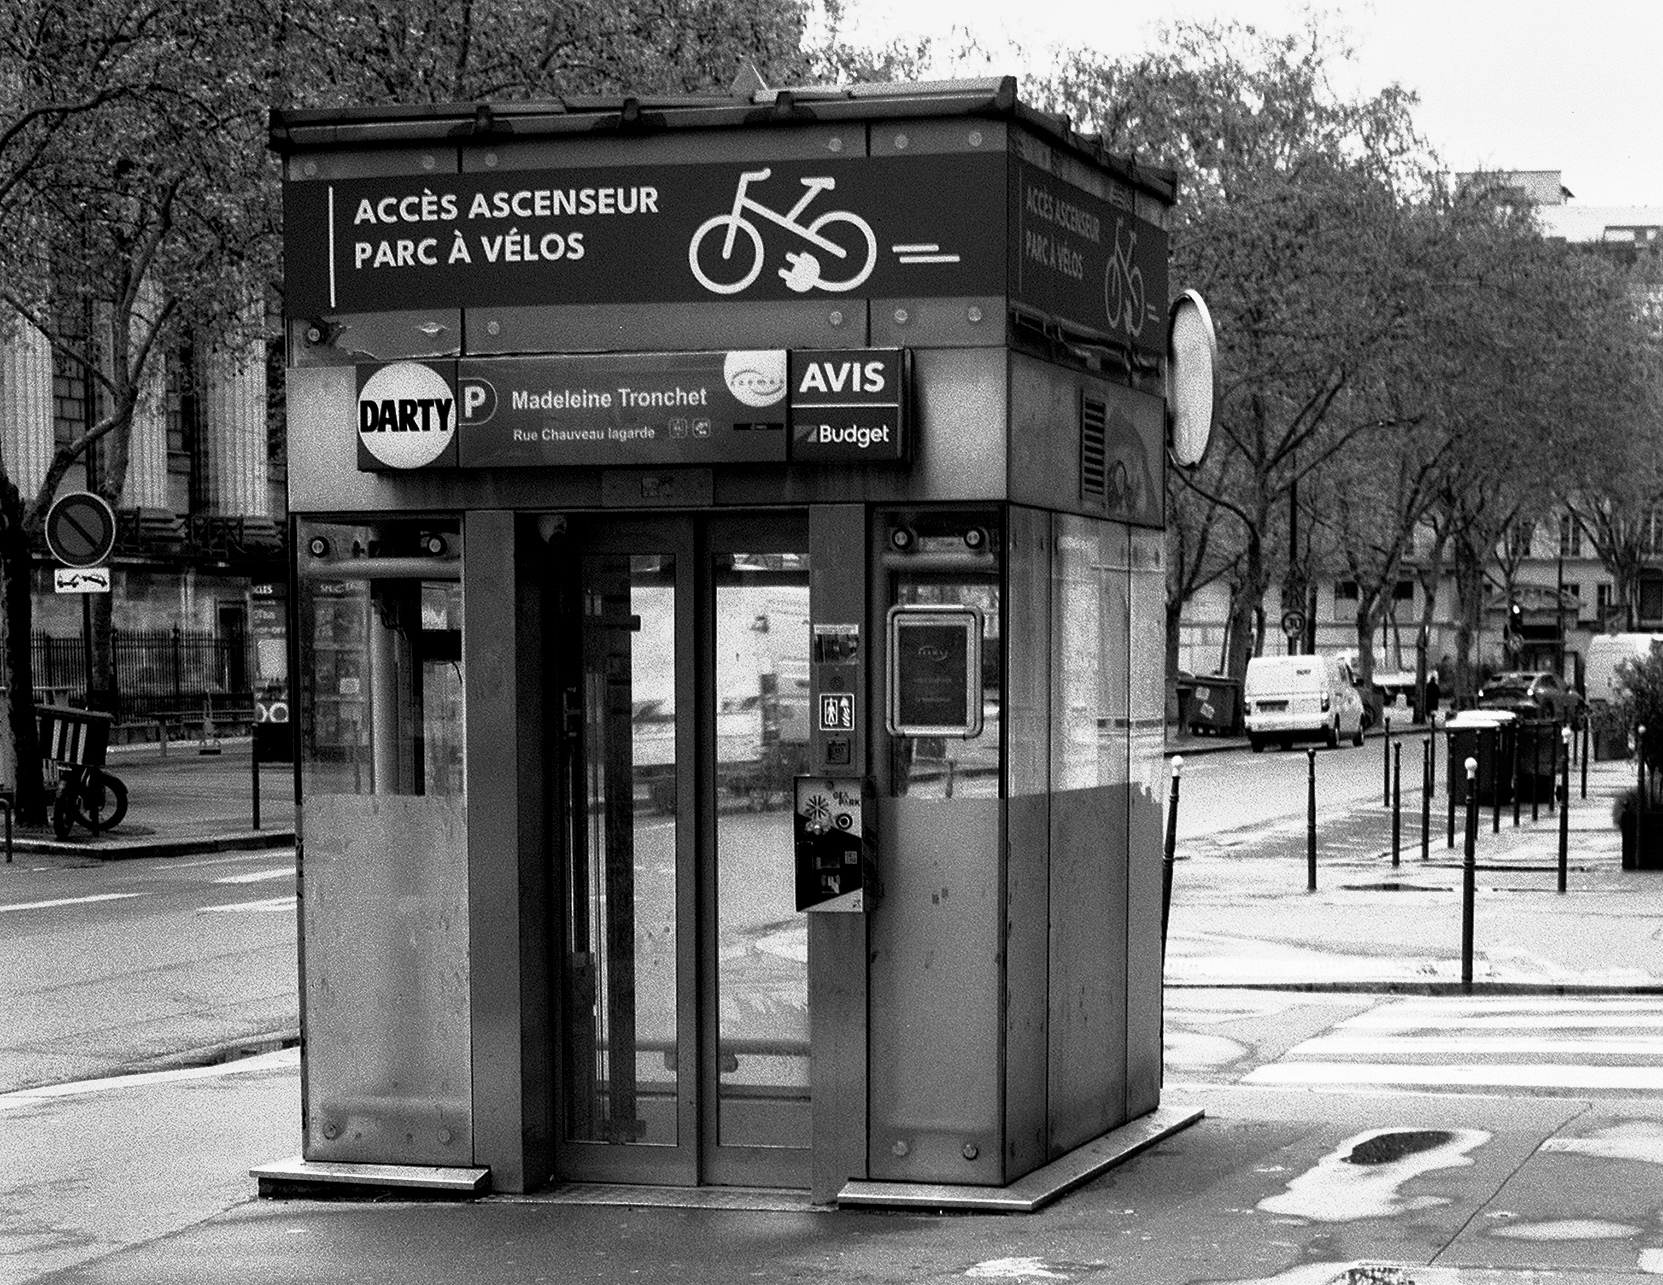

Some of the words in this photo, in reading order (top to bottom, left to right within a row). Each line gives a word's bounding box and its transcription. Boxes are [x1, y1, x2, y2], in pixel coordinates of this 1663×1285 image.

[353, 188, 458, 225] ACCÈS
[468, 186, 660, 219] ASCENSEUR
[354, 238, 438, 269] PARC
[448, 229, 472, 264] À
[480, 227, 585, 263] VÉLOS
[799, 361, 886, 393] AVIS
[511, 388, 612, 410] Madeleine
[618, 386, 708, 408] Tronchet
[358, 397, 454, 432] DARTY
[513, 428, 538, 441] Rue
[541, 427, 604, 441] Chauveau
[819, 424, 889, 447] Budget
